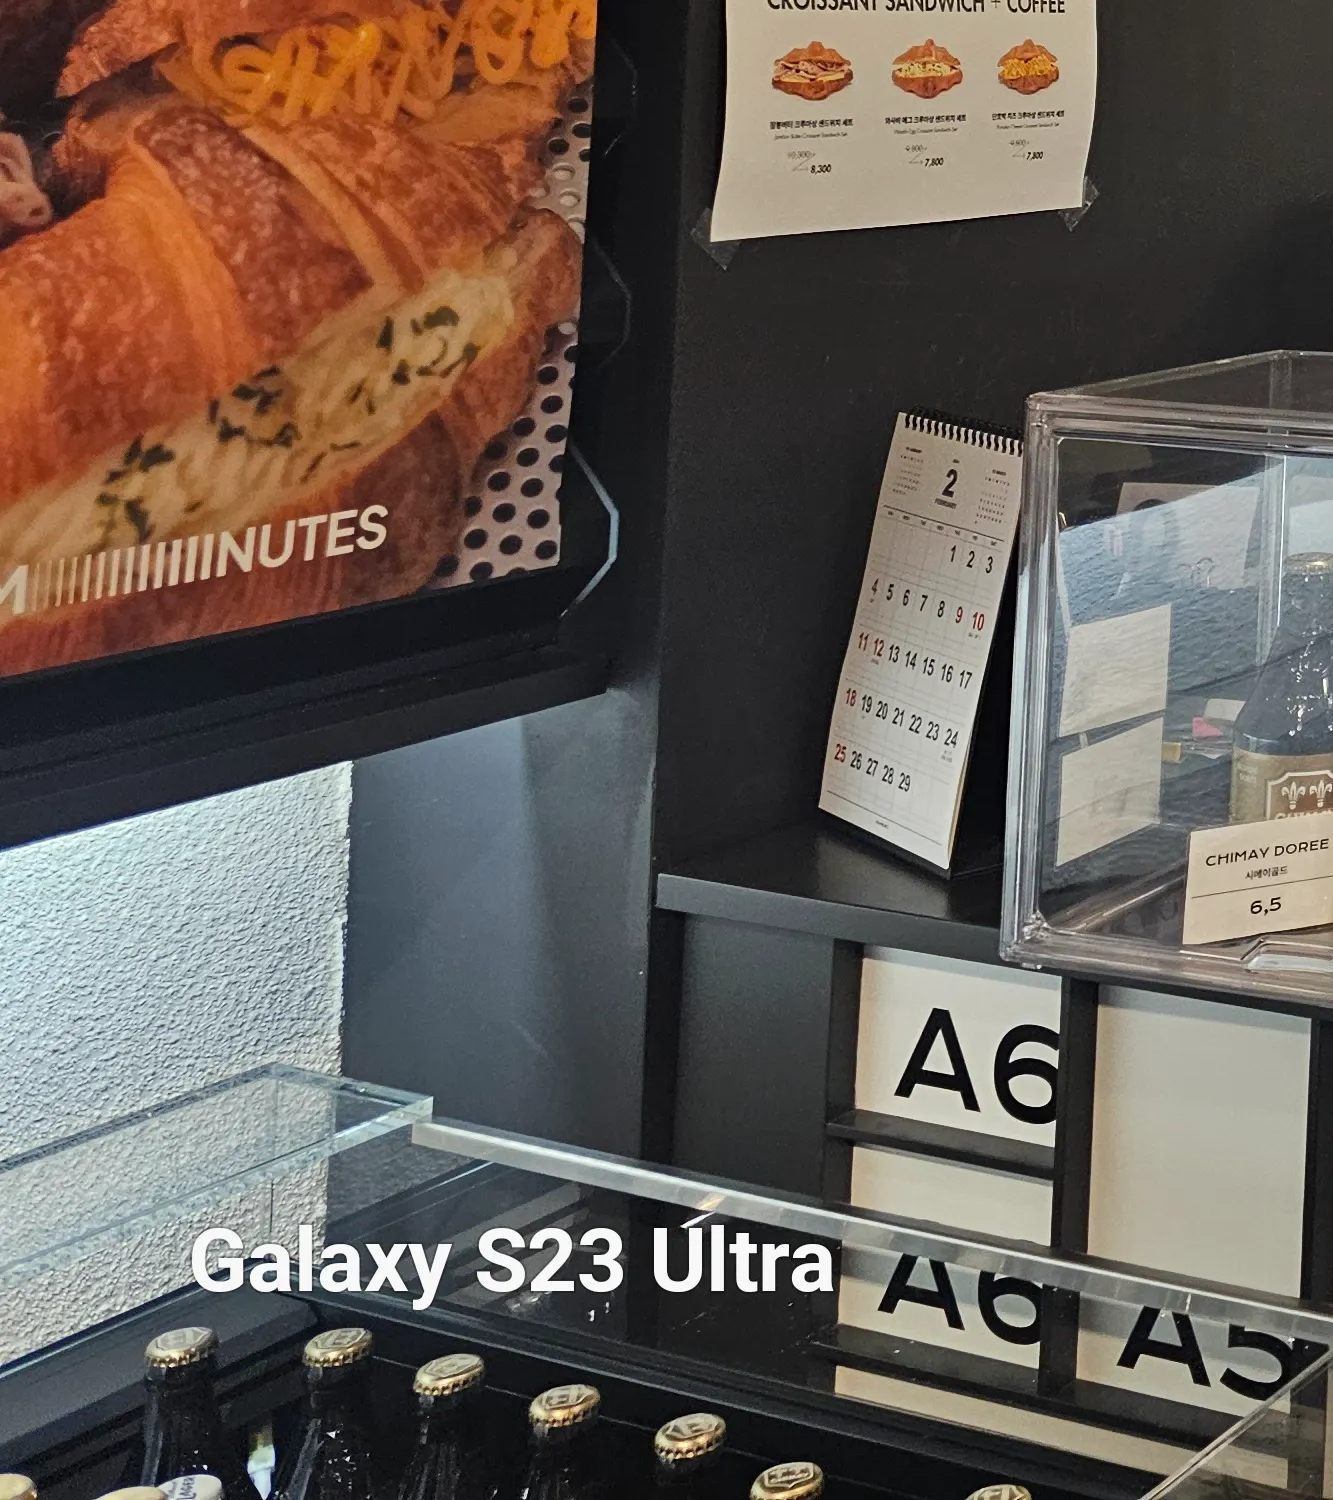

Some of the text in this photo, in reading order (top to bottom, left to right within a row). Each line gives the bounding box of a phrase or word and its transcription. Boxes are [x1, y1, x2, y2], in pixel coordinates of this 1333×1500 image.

[942, 469, 957, 498] 2
[859, 633, 972, 688] 11 12 13 14 15 16 17
[1206, 839, 1329, 866] CHIMAY DOREE
[1251, 897, 1281, 915] 6,5
[891, 1005, 1060, 1127] A6
